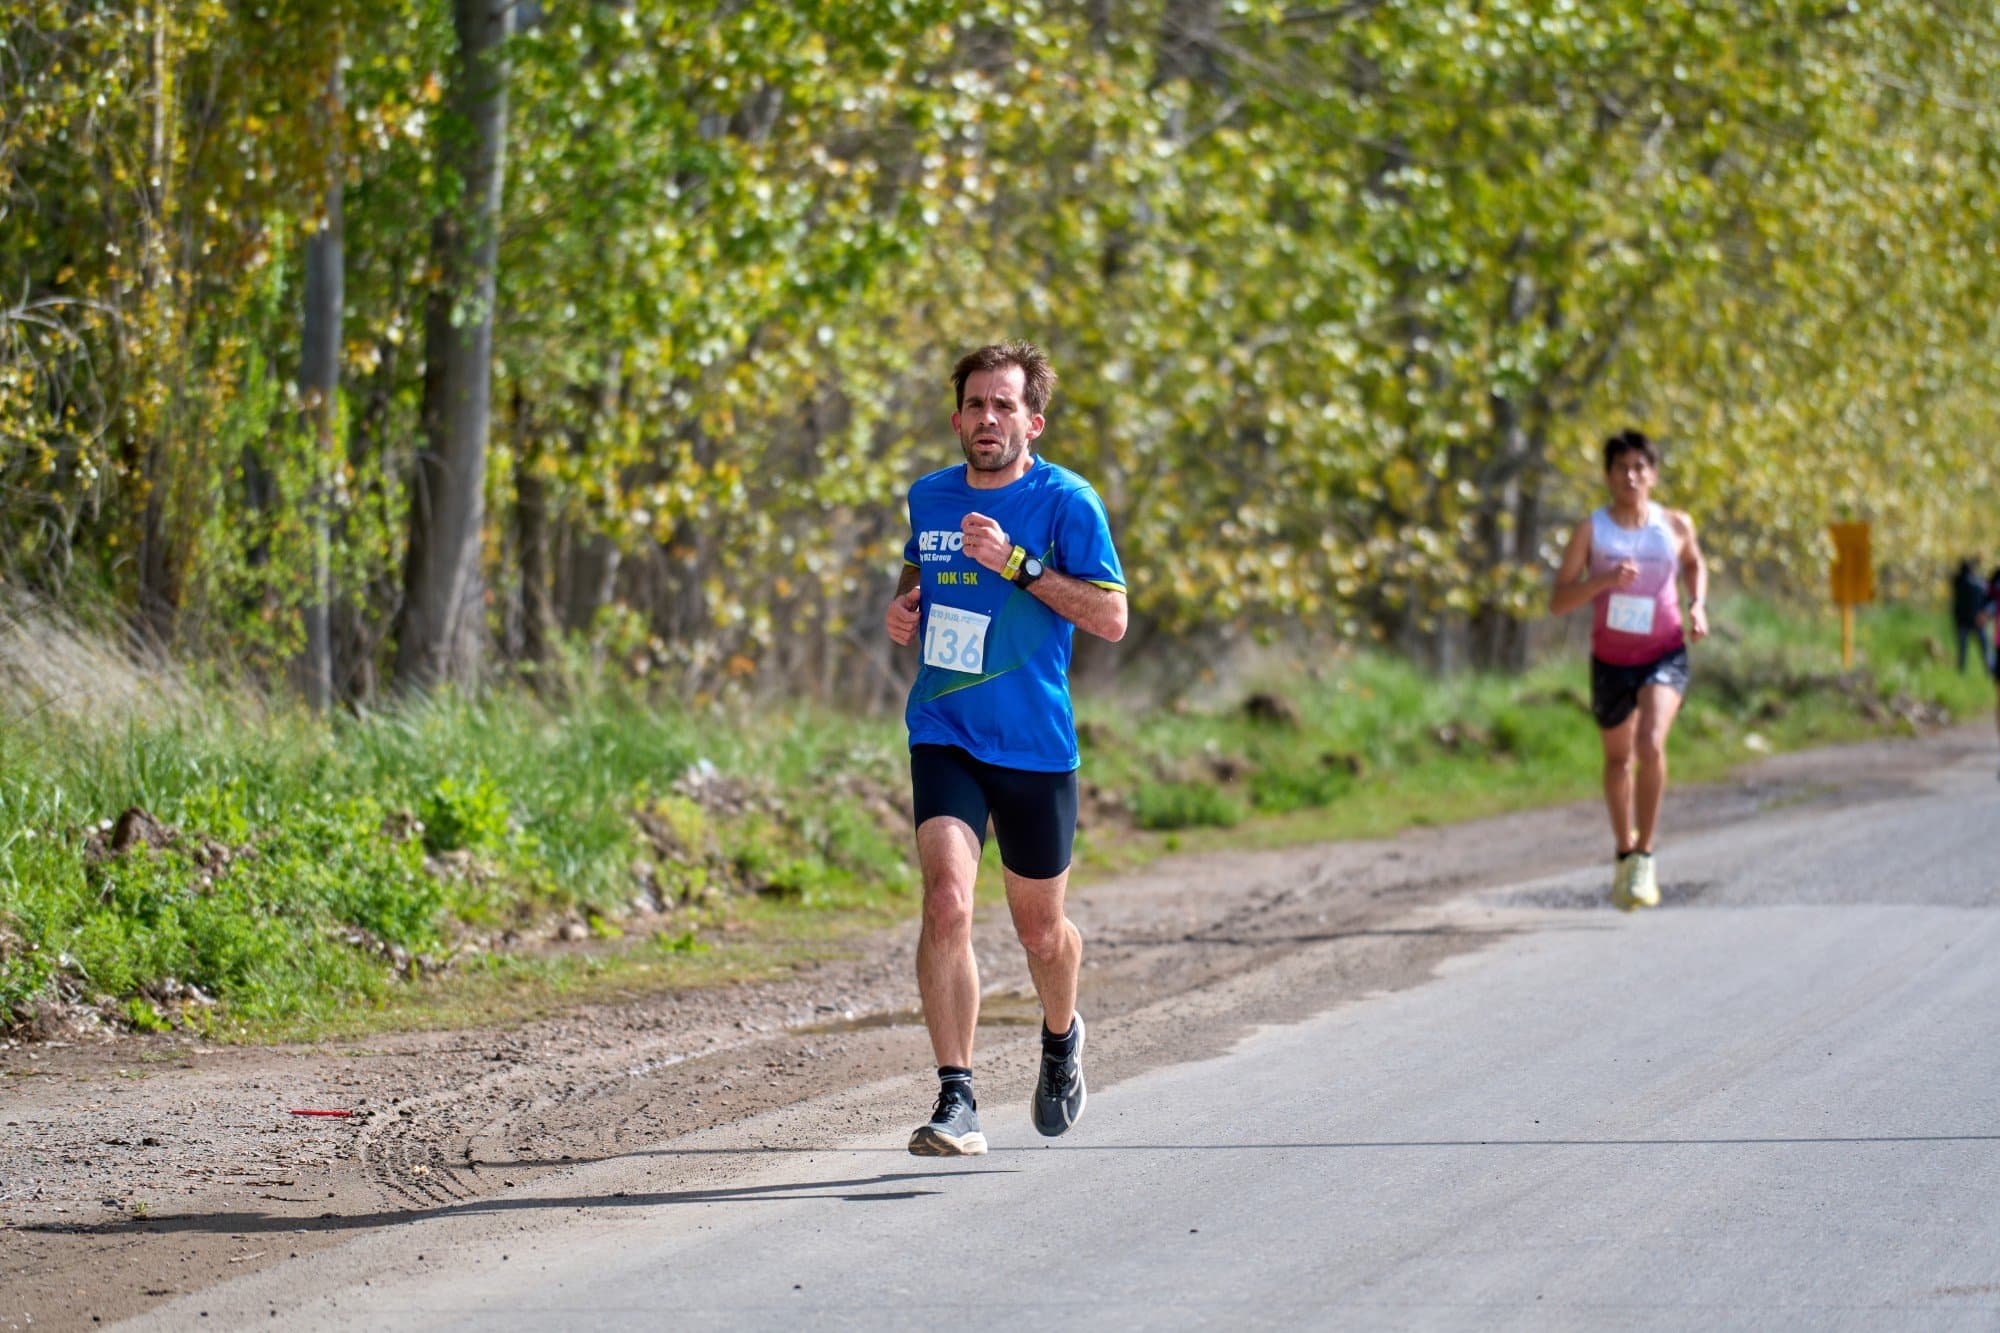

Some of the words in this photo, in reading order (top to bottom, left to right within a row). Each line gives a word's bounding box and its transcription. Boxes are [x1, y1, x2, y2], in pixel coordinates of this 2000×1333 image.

[919, 530, 963, 551] RETO
[932, 553, 951, 562] Group
[937, 571, 958, 585] 10K
[963, 572, 978, 585] 5K
[928, 626, 980, 669] 136
